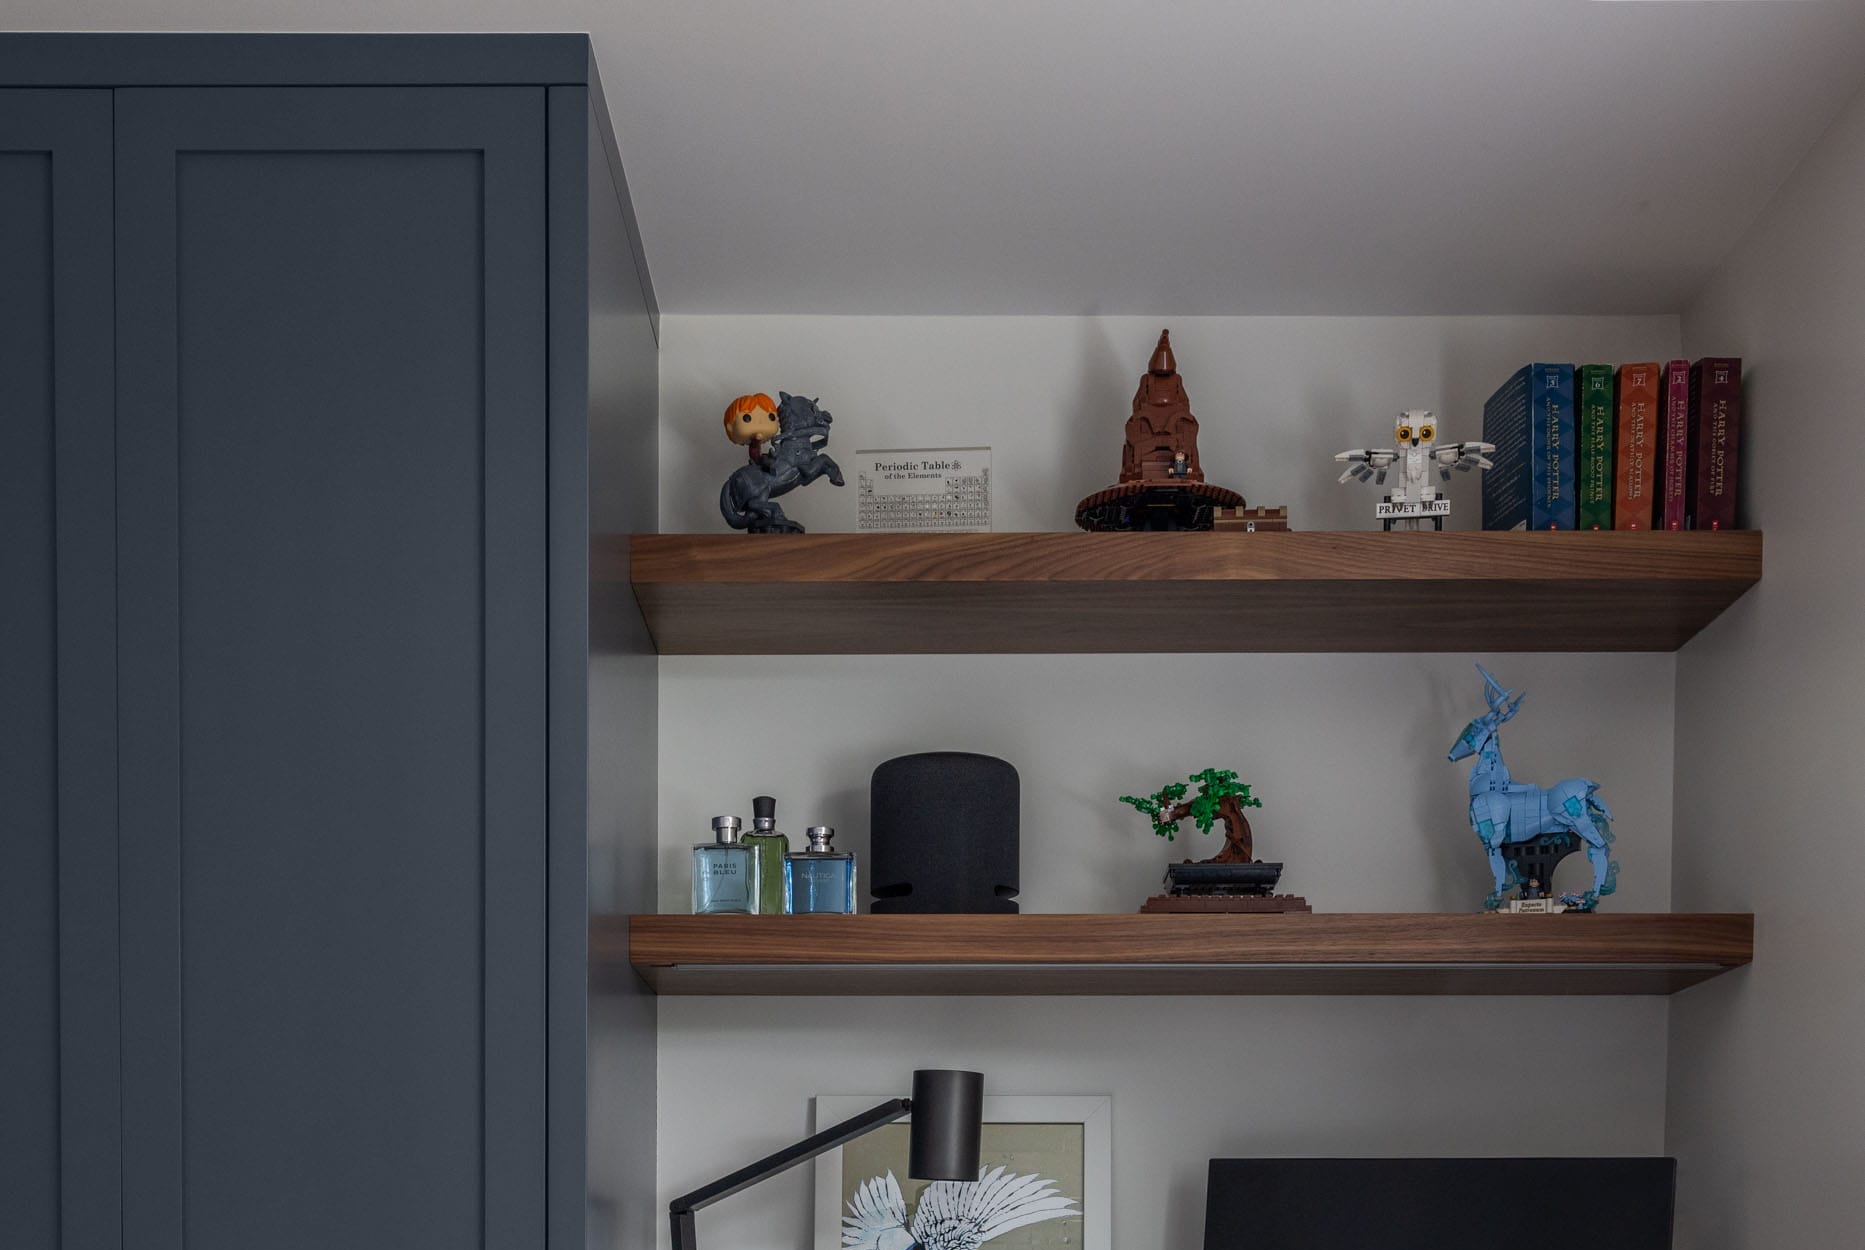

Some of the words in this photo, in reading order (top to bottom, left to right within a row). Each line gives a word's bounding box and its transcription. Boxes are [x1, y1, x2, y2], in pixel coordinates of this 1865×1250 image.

[1552, 404, 1560, 450] HARRY
[1596, 406, 1605, 451] HARRY
[1636, 402, 1645, 448] HARRY
[1676, 400, 1685, 446] HARRY
[1717, 400, 1727, 446] HARRY
[875, 462, 919, 472] Periodic
[921, 460, 951, 471] Table
[908, 472, 942, 480] Elements
[1551, 454, 1560, 501] POTTER
[1595, 455, 1604, 502] POTTER
[1633, 452, 1643, 499] POTTER
[1674, 450, 1683, 497] POTTER
[1715, 450, 1725, 497] POTTER
[1378, 504, 1417, 514] PRIVET
[1421, 502, 1449, 512] DRIVE
